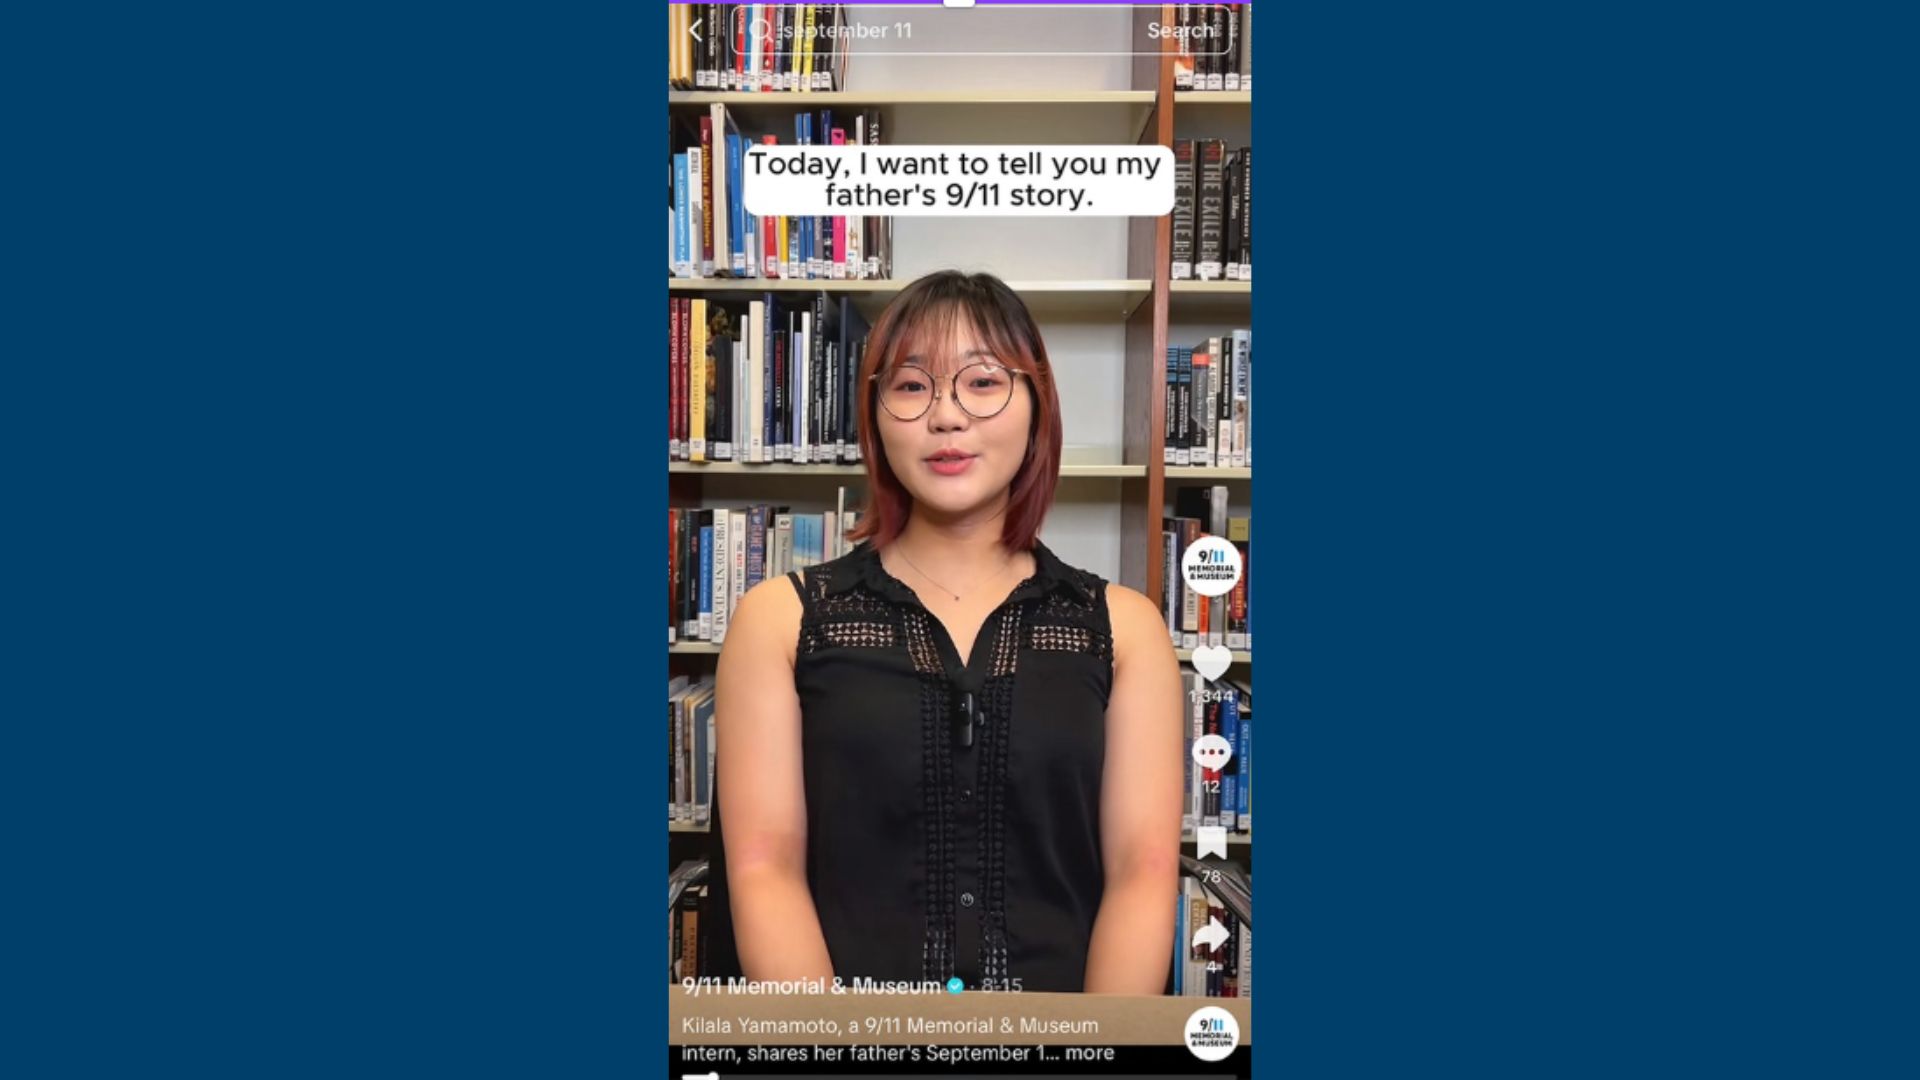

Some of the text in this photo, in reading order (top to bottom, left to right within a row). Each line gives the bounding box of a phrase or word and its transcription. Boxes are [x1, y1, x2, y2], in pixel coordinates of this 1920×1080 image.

[1175, 163, 1193, 189] THE
[1203, 163, 1221, 190] THE
[1174, 196, 1193, 237] EXILE
[1202, 196, 1221, 237] EXILE
[751, 524, 763, 549] GAME
[715, 522, 726, 626] PRESIDENT'S TEAM
[751, 552, 763, 576] MUST
